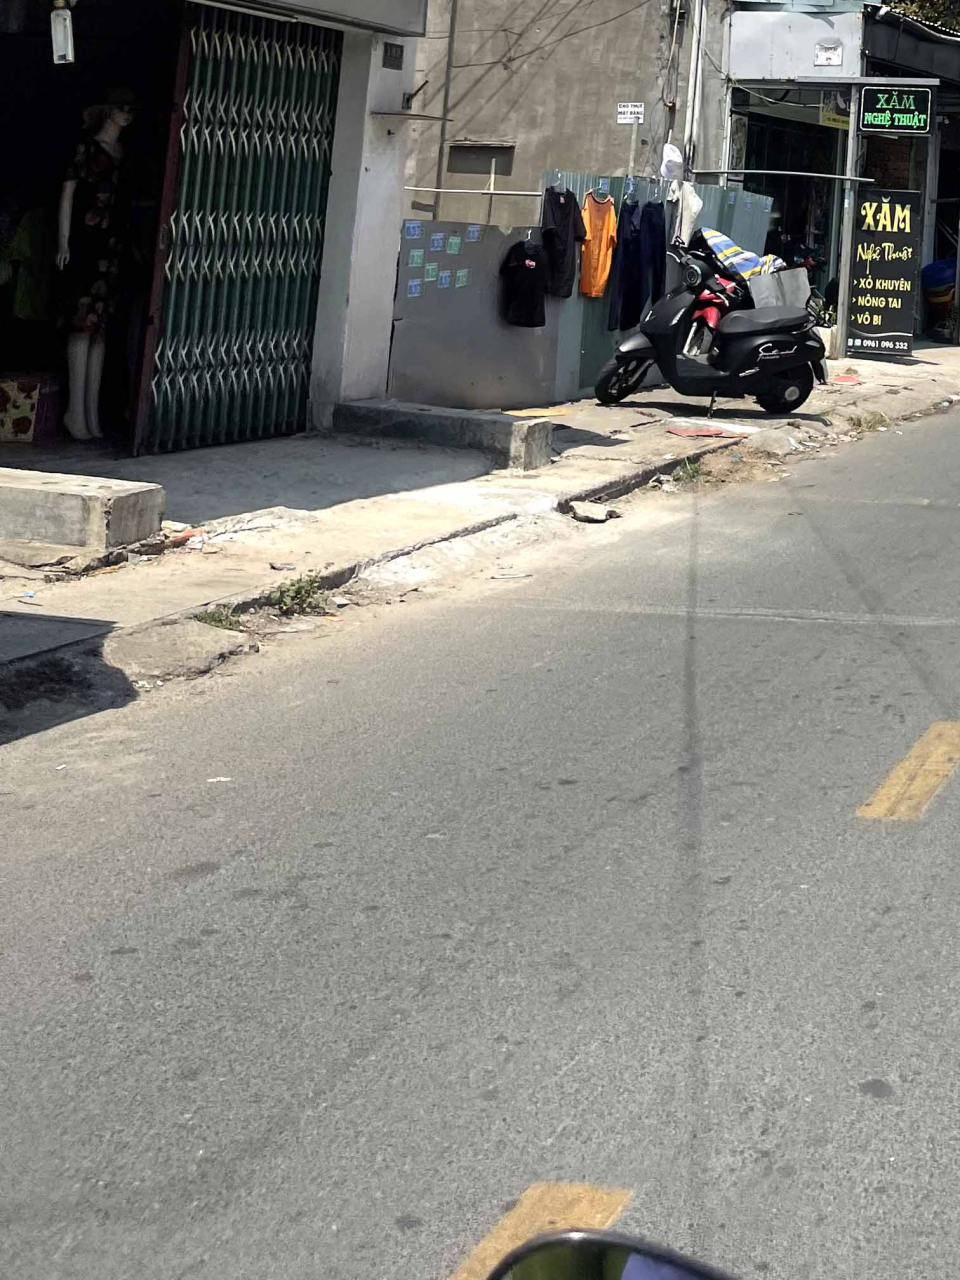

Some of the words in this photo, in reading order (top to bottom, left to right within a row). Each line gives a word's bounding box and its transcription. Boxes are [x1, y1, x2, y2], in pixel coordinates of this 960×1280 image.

[876, 91, 916, 110] XĂM
[863, 110, 891, 127] NGHỆ
[892, 111, 927, 129] THUẬT
[860, 196, 912, 233] XĂM
[856, 242, 882, 275] Nghệ
[881, 242, 913, 262] Thuật
[858, 275, 874, 290] XỎ
[875, 277, 912, 292] KHUYÊN
[857, 294, 887, 308] NÔNG
[888, 297, 902, 309] TAI
[872, 314, 882, 326] BI
[862, 340, 879, 348] 0961
[880, 341, 894, 349] 096
[894, 342, 909, 350] 332
